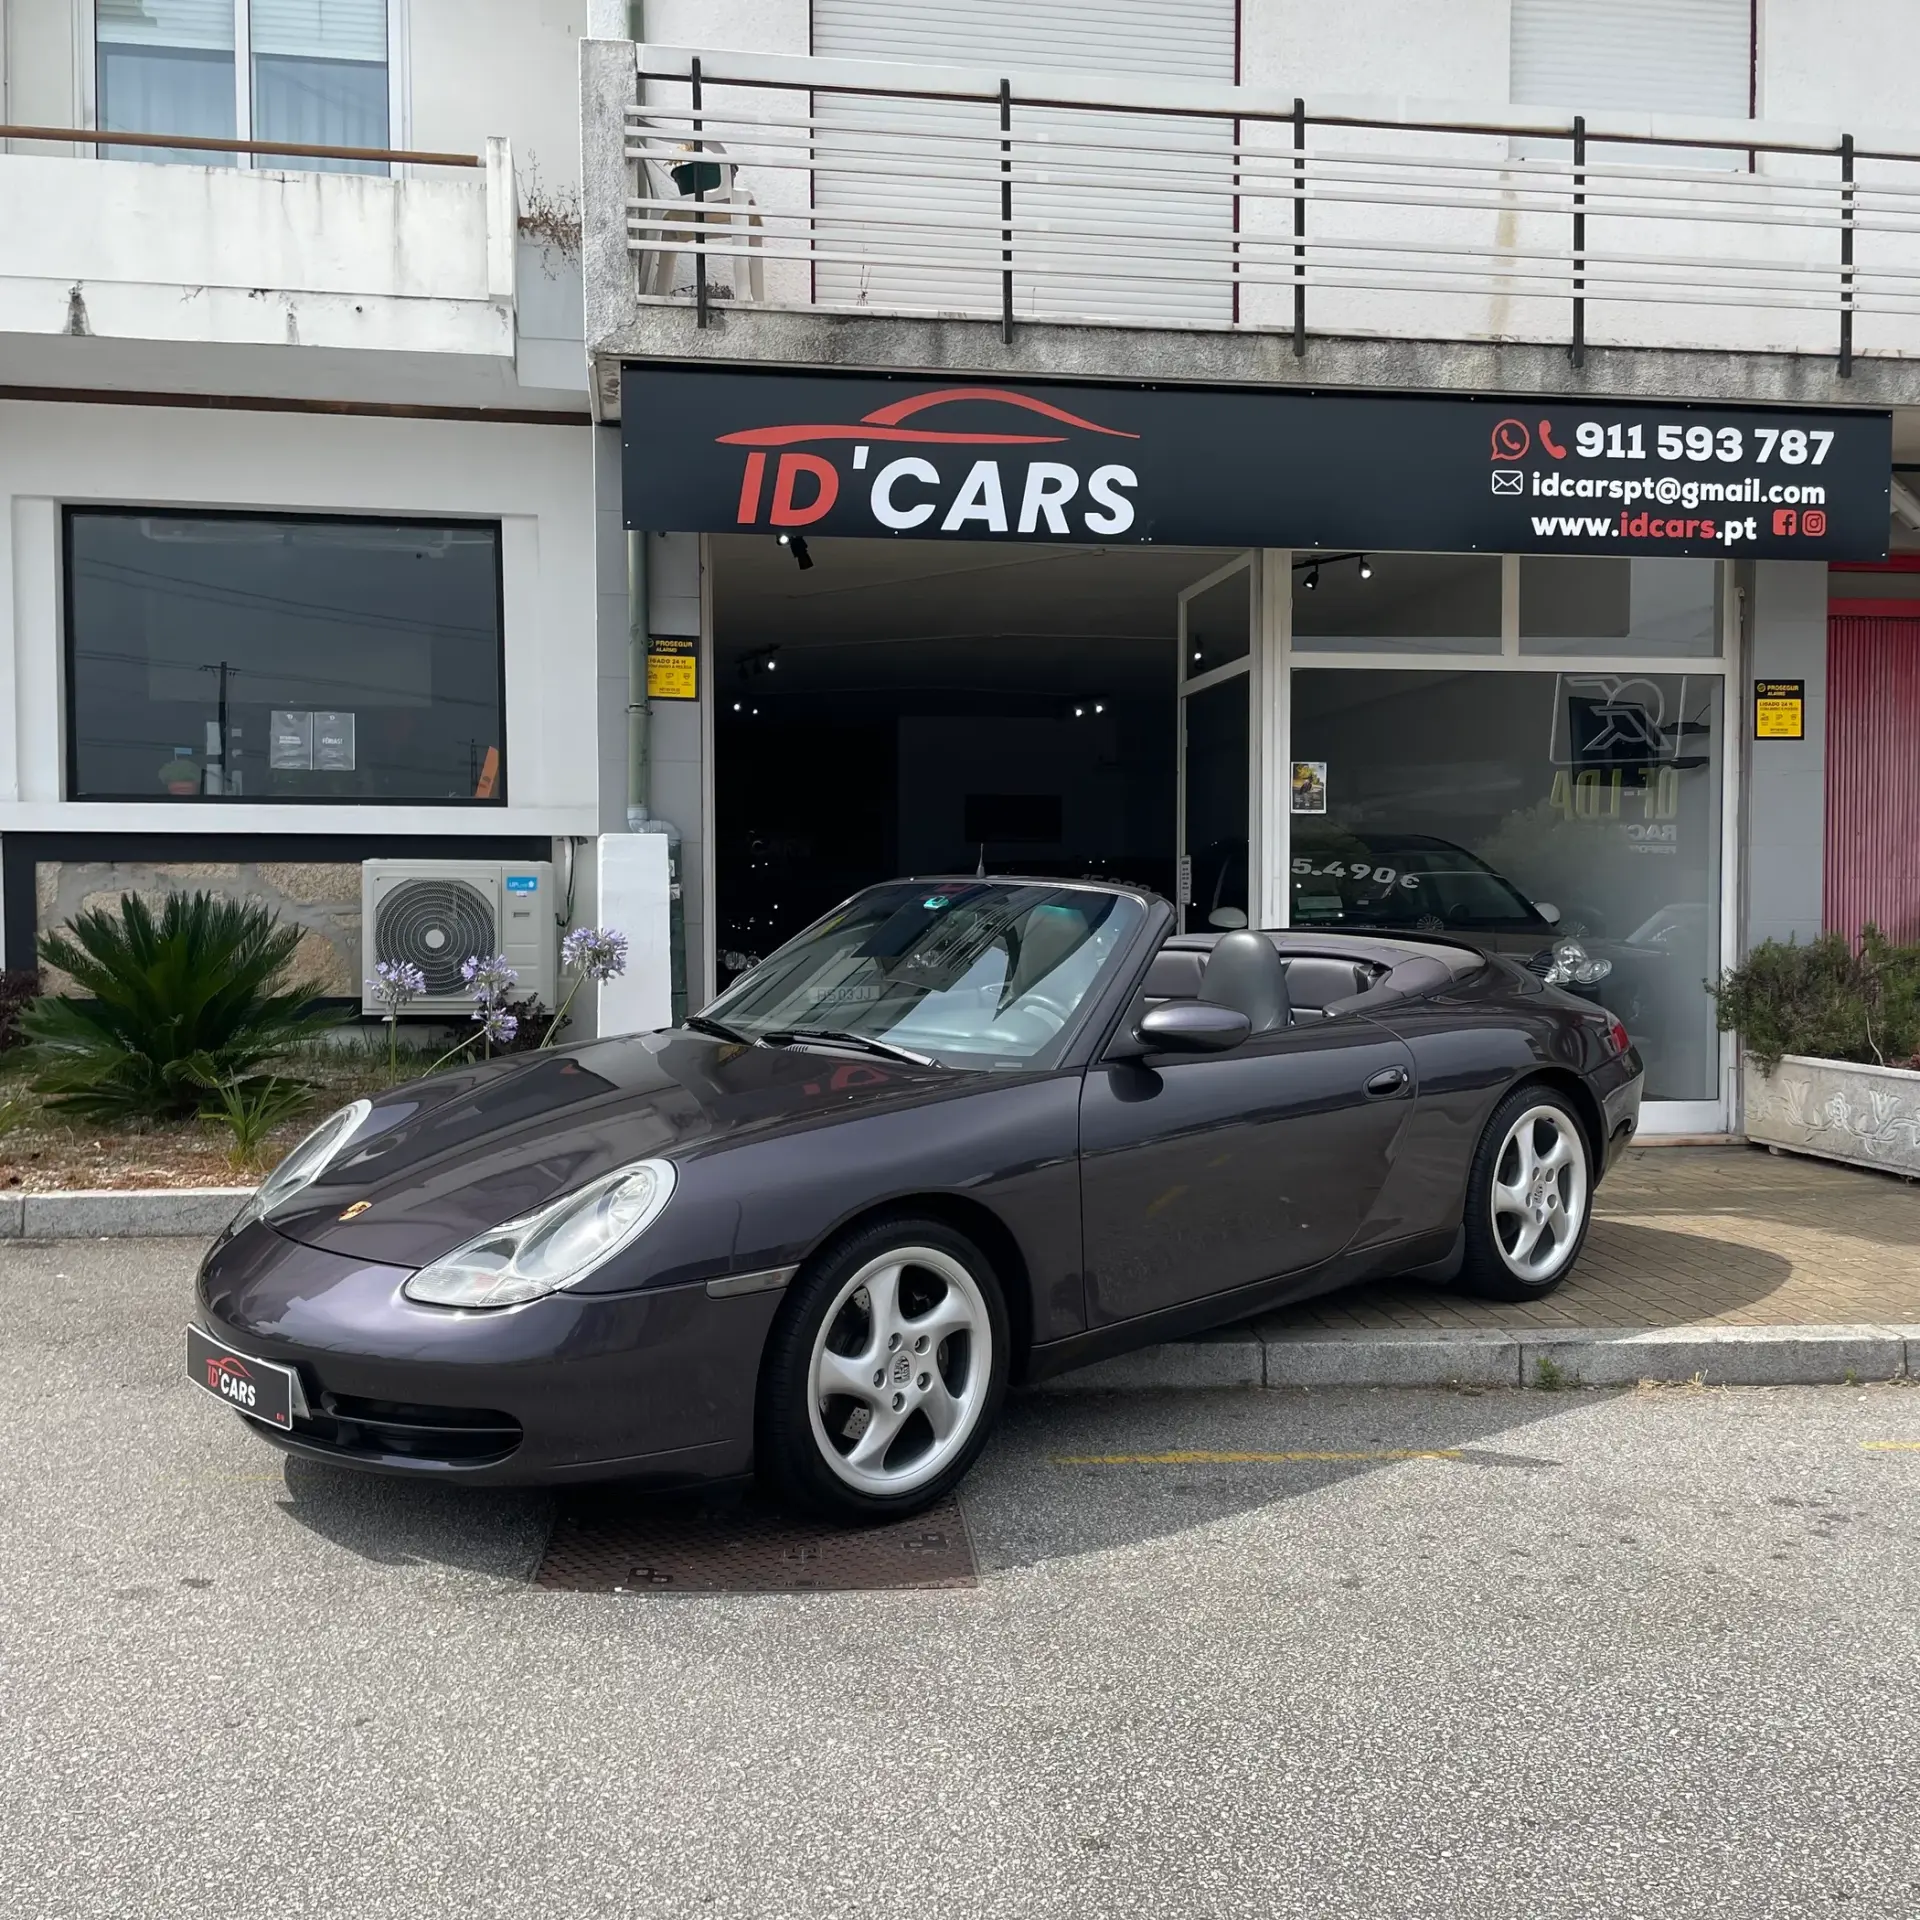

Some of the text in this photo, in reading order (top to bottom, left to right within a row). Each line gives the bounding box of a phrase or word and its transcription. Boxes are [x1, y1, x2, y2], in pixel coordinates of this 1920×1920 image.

[1575, 421, 1835, 466] 911 593 787
[735, 445, 1140, 536] ID'CARS
[1531, 470, 1826, 509] idcarspt@gmail.com
[1531, 511, 1758, 547] www.idcars.pt
[656, 640, 693, 648] PROSEGUR
[1290, 857, 1420, 889] 5.490€
[208, 1365, 256, 1407] ID'CARS
